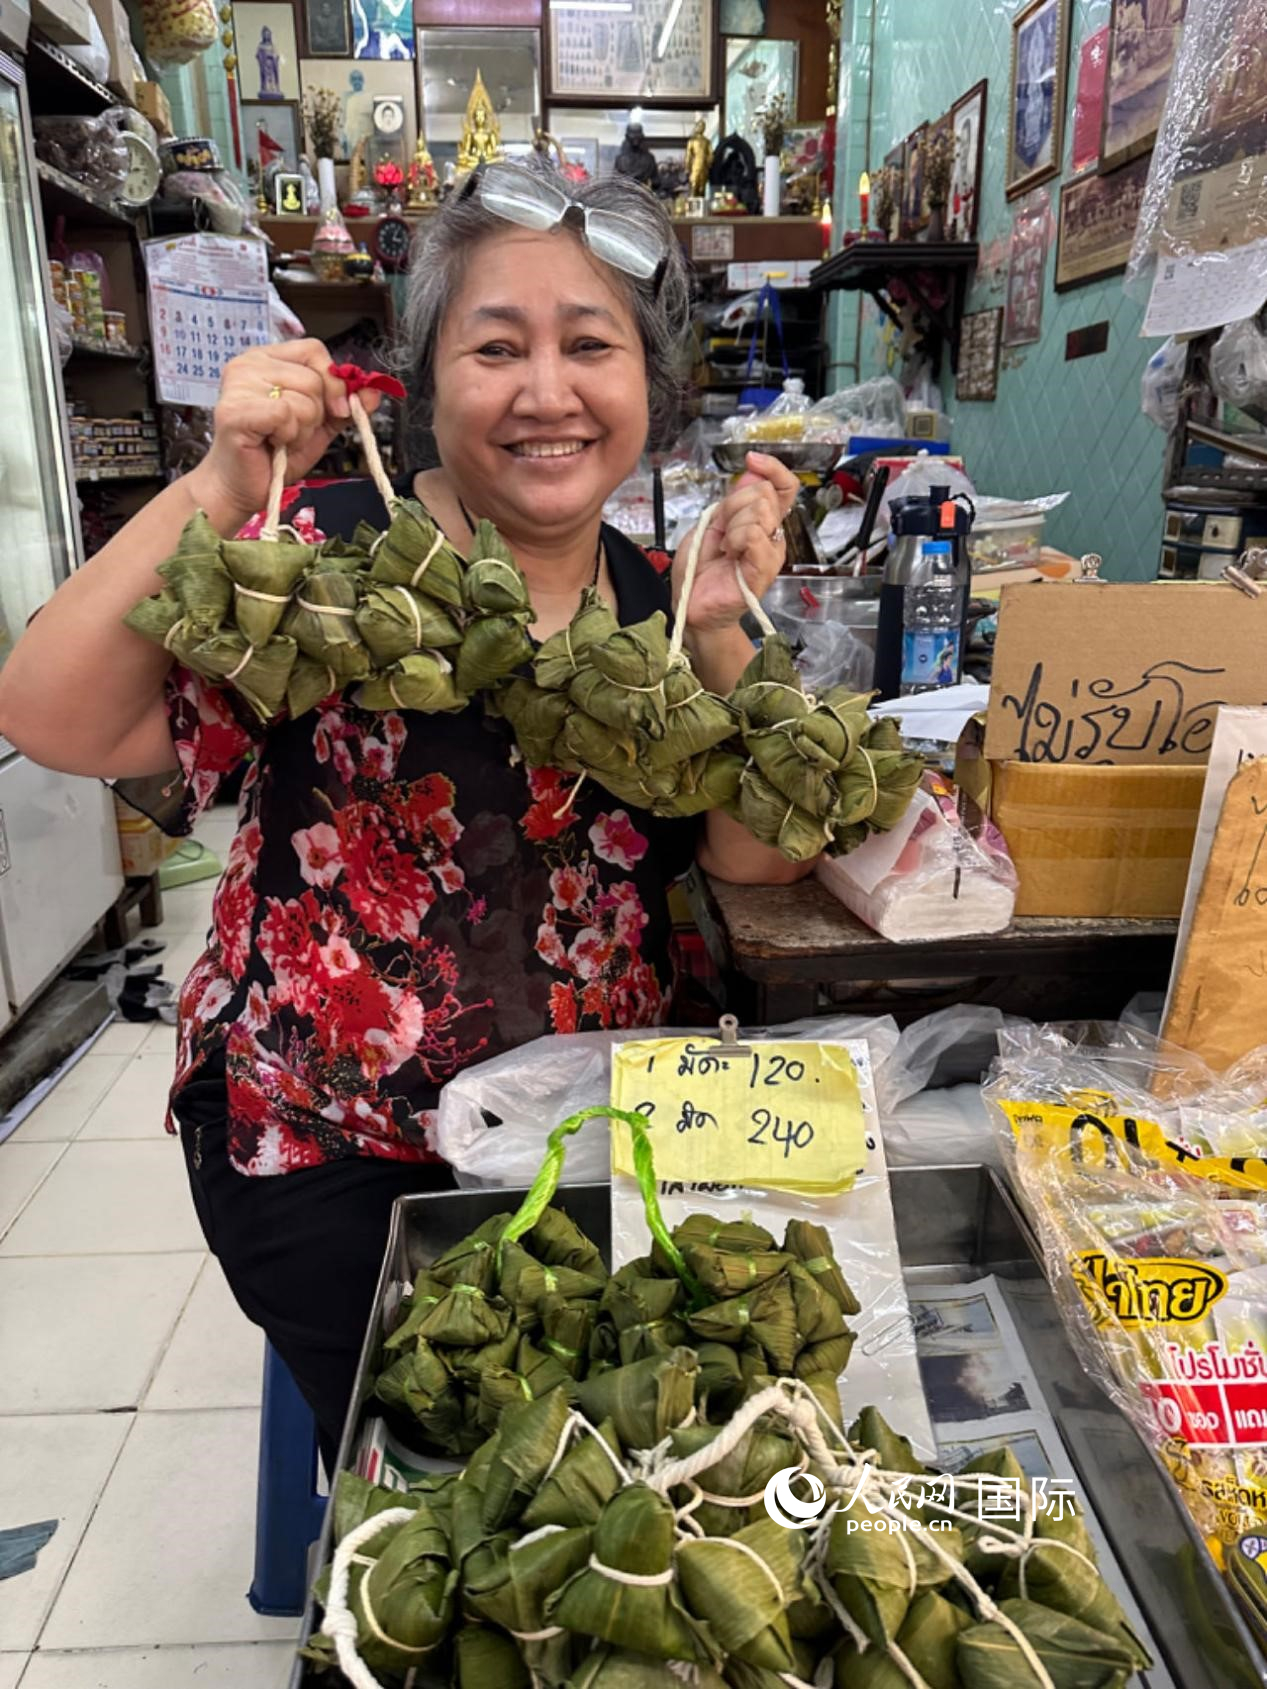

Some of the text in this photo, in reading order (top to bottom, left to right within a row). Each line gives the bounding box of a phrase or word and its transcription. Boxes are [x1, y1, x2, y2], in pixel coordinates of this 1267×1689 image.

[160, 308, 167, 320] 2
[192, 314, 199, 325] 4
[208, 316, 215, 328] 5
[242, 320, 248, 331] 7
[175, 329, 187, 340] 10
[191, 331, 201, 342] 11
[207, 333, 218, 345] 12
[224, 335, 235, 347] 13
[241, 336, 251, 347] 14
[176, 346, 187, 358] 17
[192, 348, 203, 360] 18
[208, 350, 219, 362] 19
[176, 363, 221, 379] 24 25 26
[747, 1108, 815, 1158] 240
